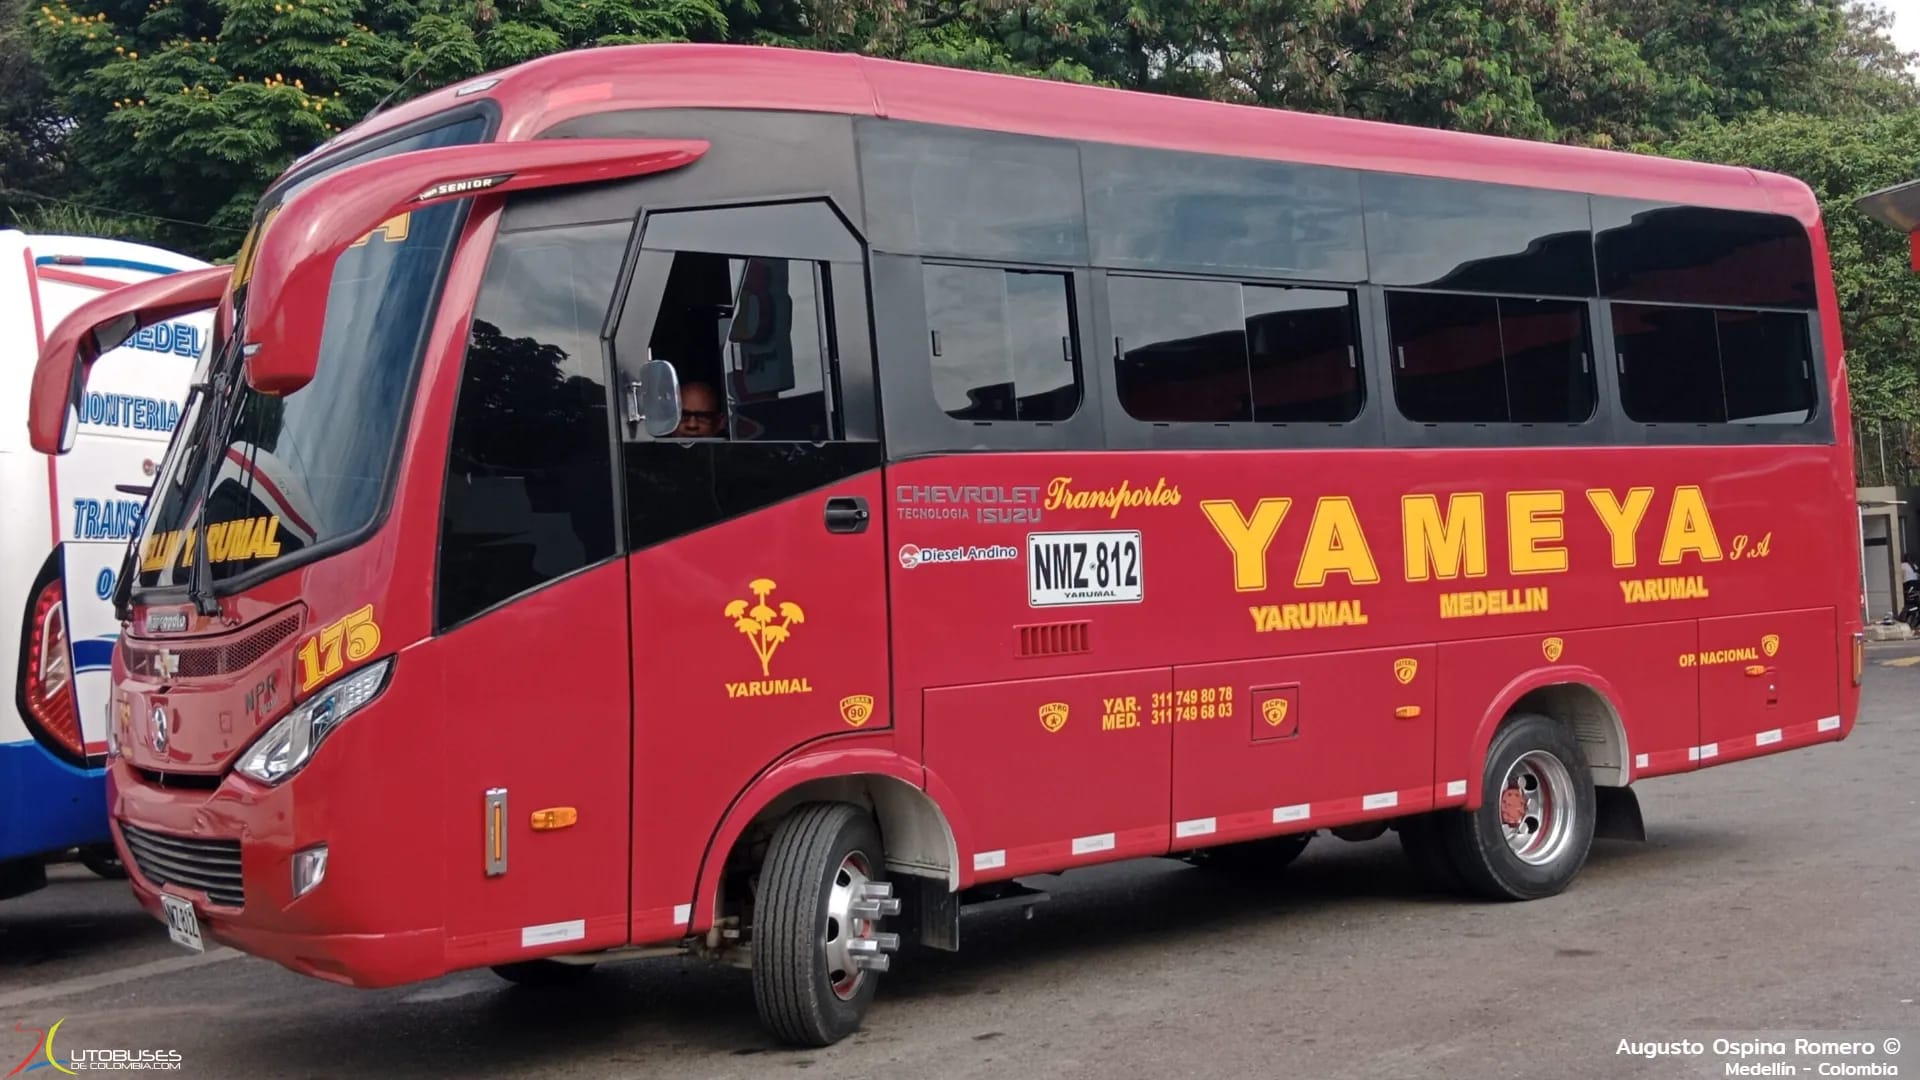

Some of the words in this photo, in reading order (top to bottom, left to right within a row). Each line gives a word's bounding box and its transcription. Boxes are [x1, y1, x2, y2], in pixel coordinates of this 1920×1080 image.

[439, 179, 493, 194] SENIOR
[896, 485, 1040, 504] CHEVROLET
[1044, 477, 1182, 519] Transportes
[897, 507, 970, 520] TECNOLOGIA
[976, 507, 1042, 523] ISUZU
[921, 547, 963, 562] Diesel
[967, 545, 1016, 560] Andino
[1064, 590, 1117, 599] YARUMAL
[1440, 587, 1549, 618] MEDELLIN
[1620, 576, 1709, 604] YARUMAL
[1250, 600, 1368, 632] YARUMAL
[299, 604, 381, 692] 175
[1679, 653, 1697, 668] OP.
[1700, 647, 1760, 666] NACIONAL
[246, 673, 277, 716] NPR
[725, 678, 813, 698] YARUMAL
[1103, 697, 1141, 714] YAR.
[1151, 691, 1173, 709] 311
[1175, 689, 1198, 706] 749
[1201, 688, 1216, 704] 80
[1219, 686, 1233, 702] 78
[850, 707, 864, 719] 90
[1102, 712, 1140, 731] MED.
[1151, 707, 1173, 725] 311
[1175, 705, 1198, 722] 749
[1200, 704, 1216, 719] 68
[1218, 702, 1233, 718] 03
